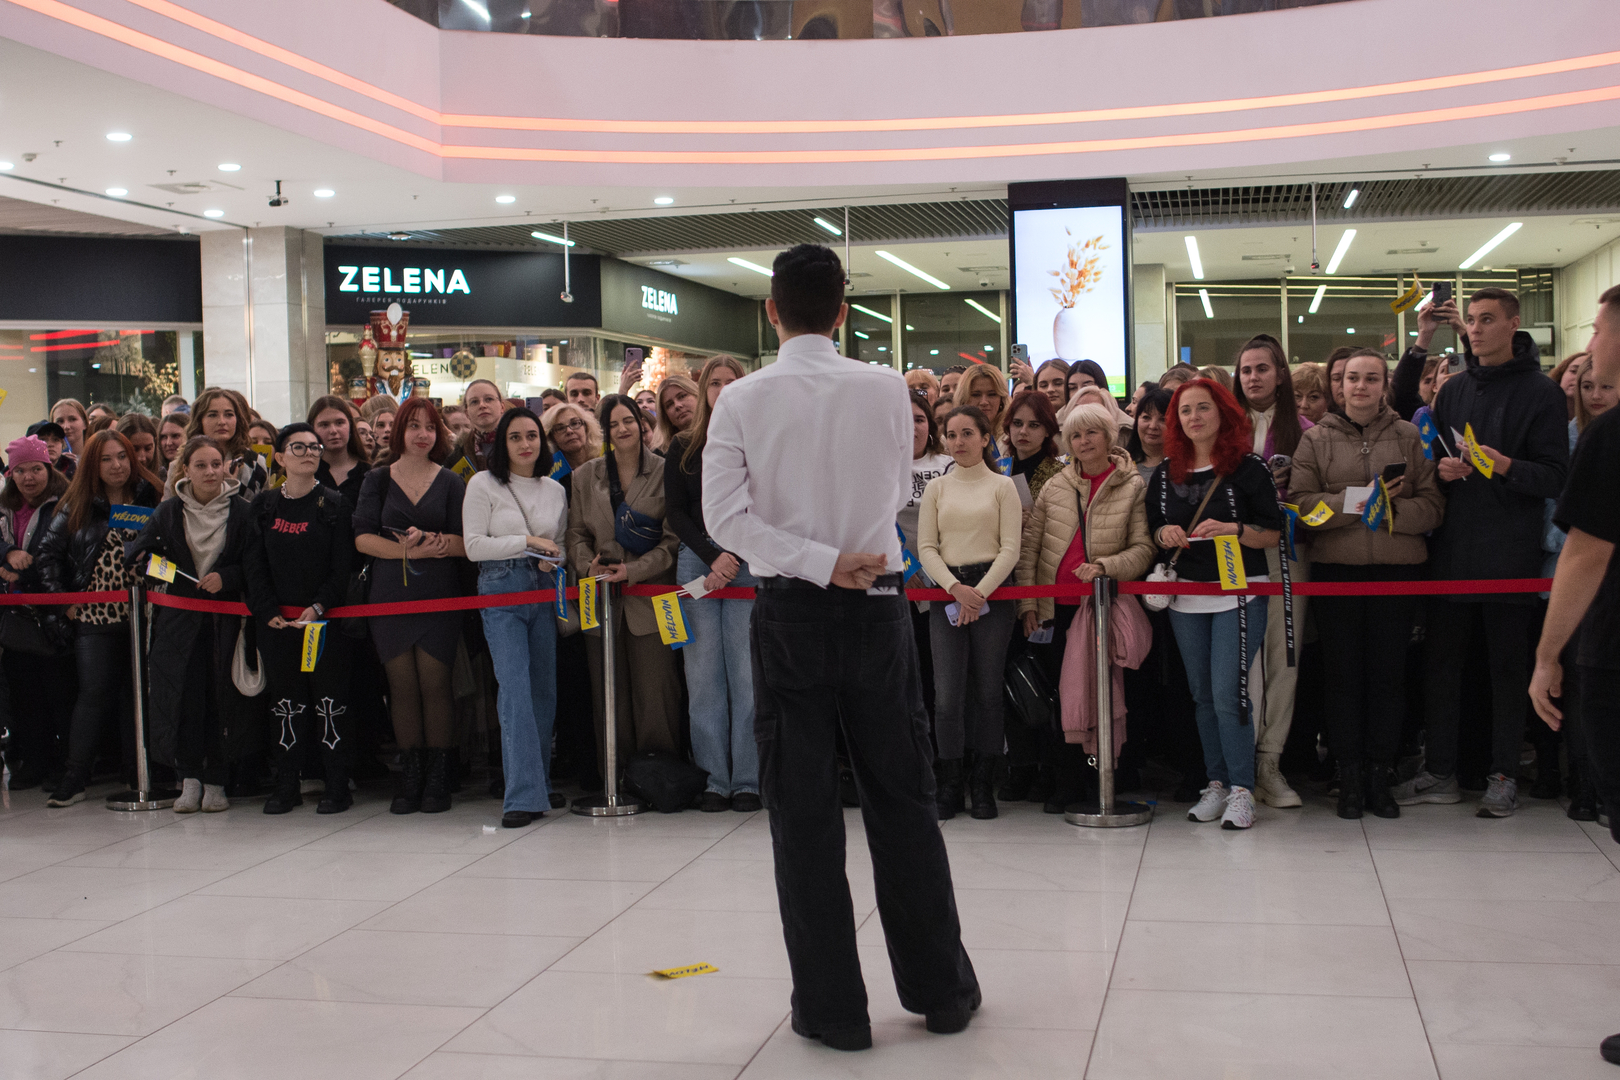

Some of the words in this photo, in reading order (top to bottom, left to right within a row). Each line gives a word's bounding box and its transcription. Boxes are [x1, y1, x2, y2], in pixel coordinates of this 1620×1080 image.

[338, 265, 471, 295] ZELENA
[641, 285, 679, 316] ZELENA
[413, 363, 449, 375] ELEN
[271, 518, 309, 535] BIEBER
